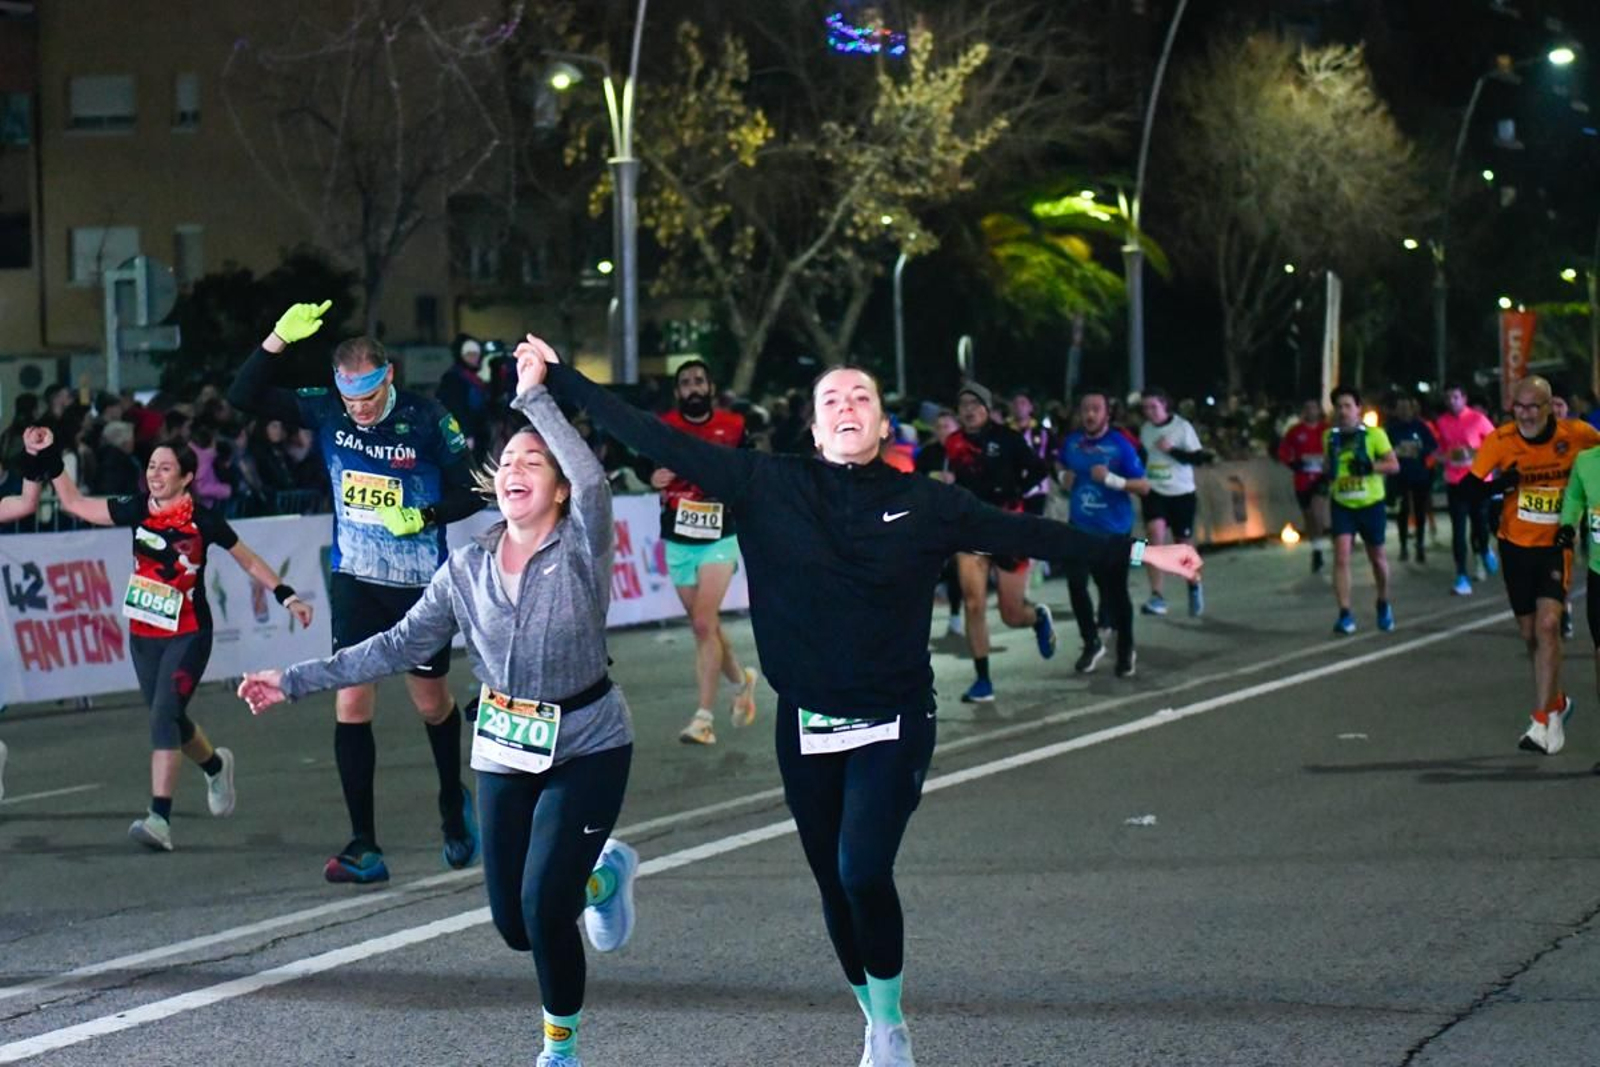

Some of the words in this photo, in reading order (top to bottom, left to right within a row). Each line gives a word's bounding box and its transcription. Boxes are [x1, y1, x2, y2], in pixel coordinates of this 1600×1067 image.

[345, 486, 396, 507] 4156
[681, 510, 719, 526] 9910
[131, 588, 176, 615] 1056
[483, 706, 549, 747] 2970
